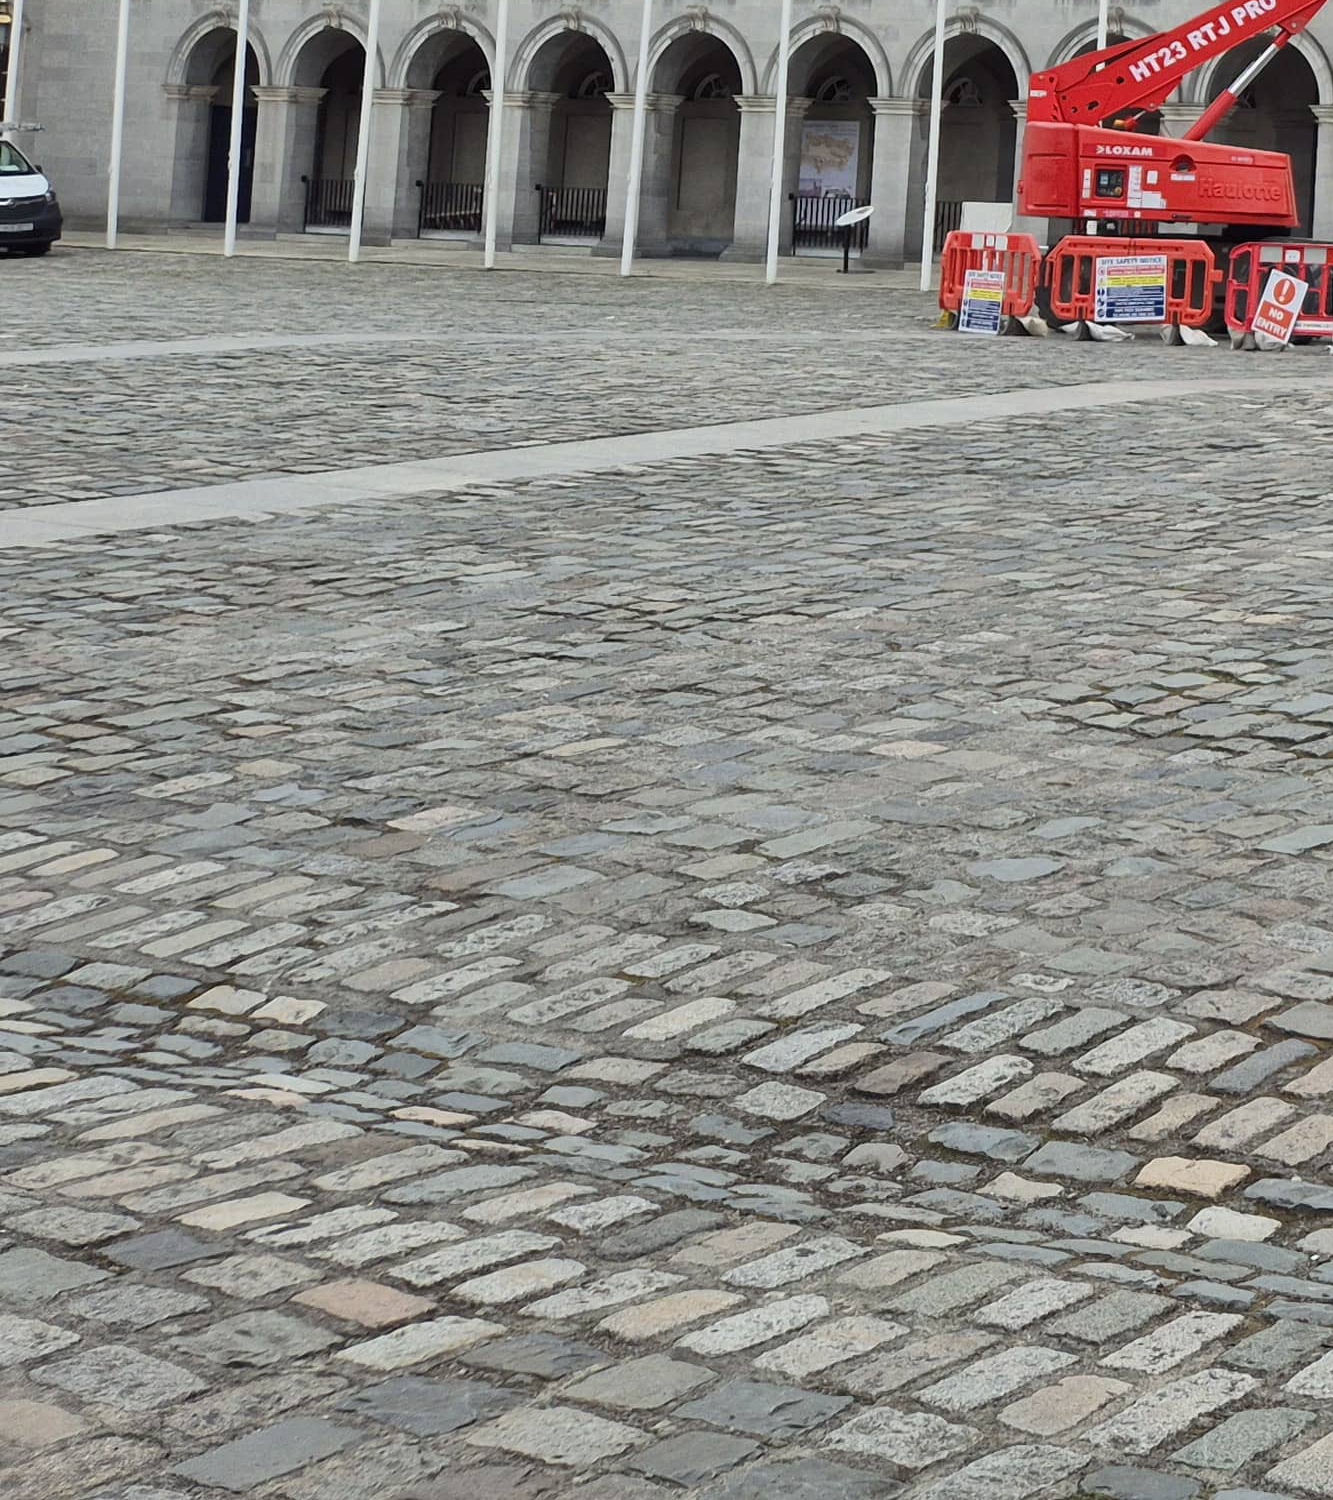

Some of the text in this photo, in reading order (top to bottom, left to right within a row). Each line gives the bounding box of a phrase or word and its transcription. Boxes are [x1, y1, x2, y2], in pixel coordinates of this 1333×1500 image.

[1128, 41, 1187, 83] HT23
[1186, 15, 1231, 51] RTJ
[1199, 177, 1281, 201] Haulotte
[1268, 307, 1284, 320] NO
[1256, 315, 1288, 337] ENTRY
